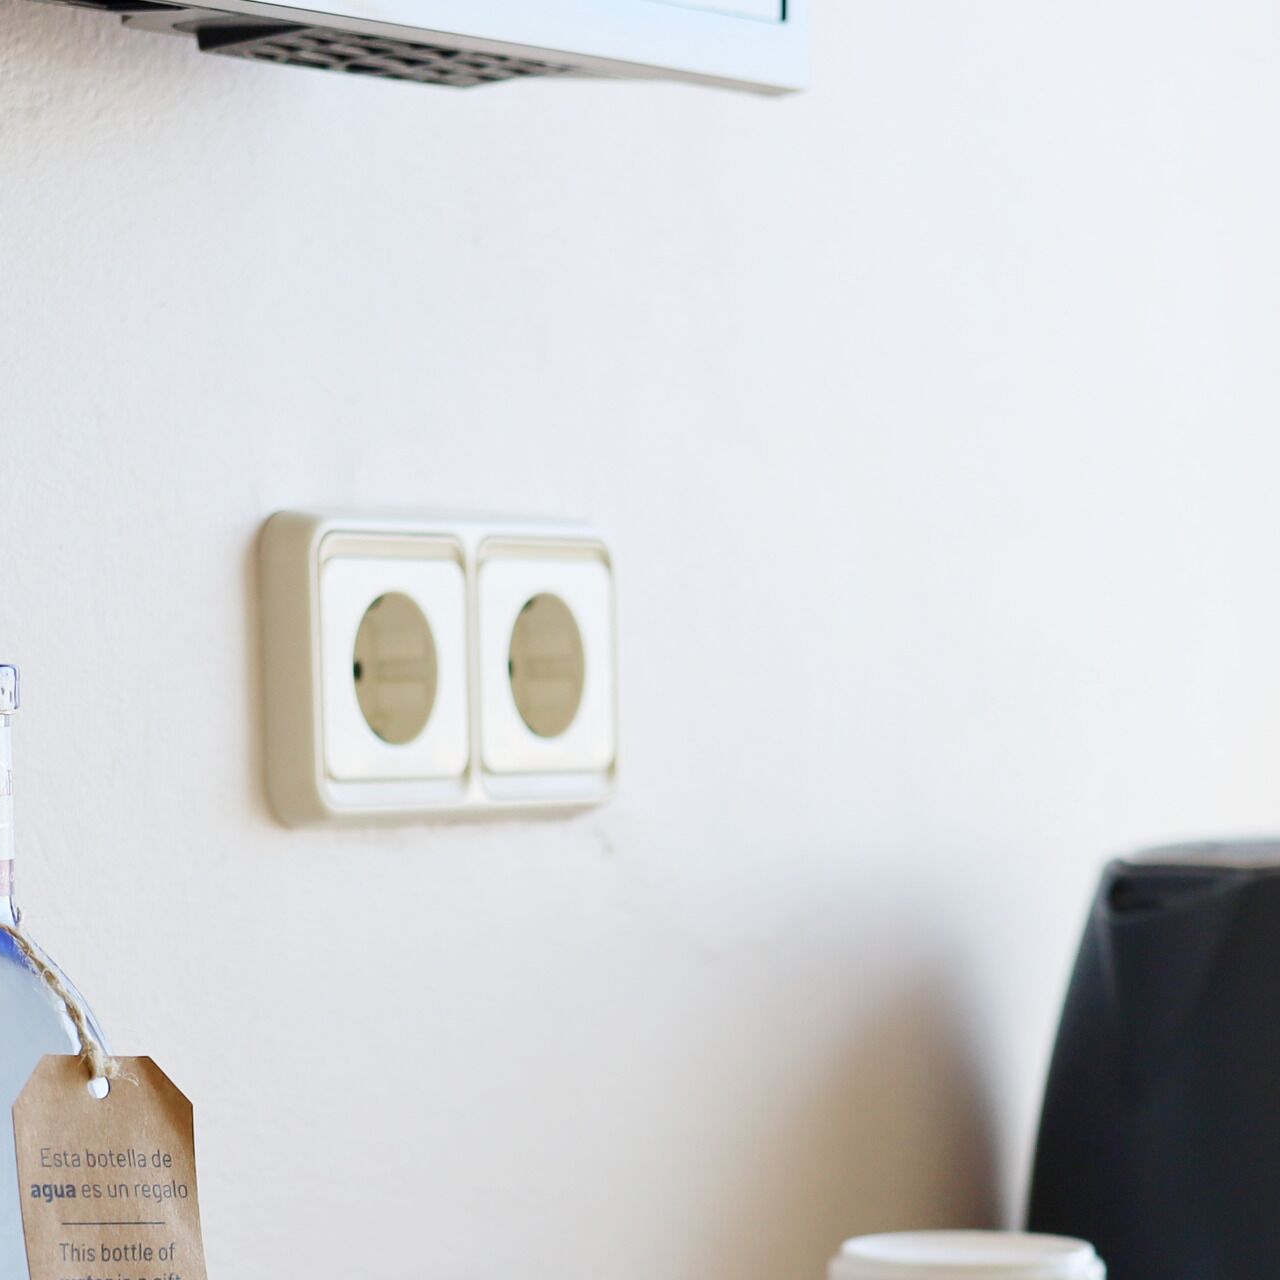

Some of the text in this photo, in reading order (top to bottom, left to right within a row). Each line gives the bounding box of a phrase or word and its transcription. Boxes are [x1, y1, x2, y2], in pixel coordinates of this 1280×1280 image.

[40, 1147, 173, 1168] Esta botella de
[30, 1179, 189, 1204] agua es un regalo
[58, 1242, 177, 1263] This bottle of
